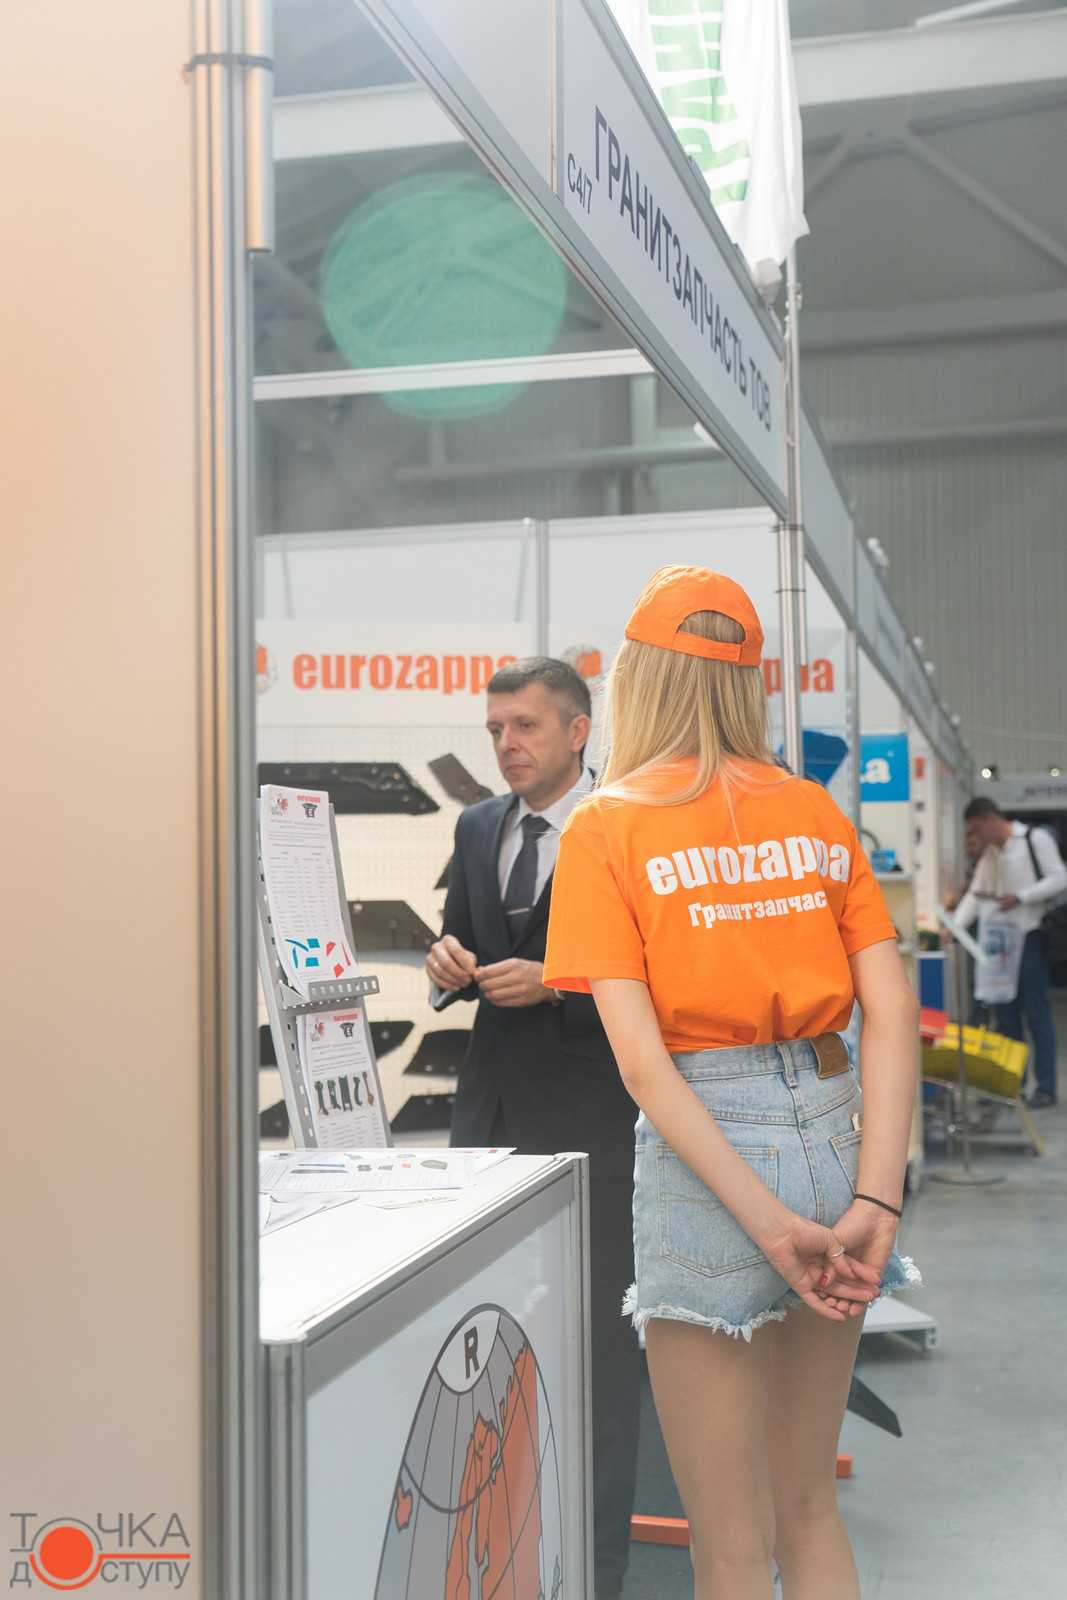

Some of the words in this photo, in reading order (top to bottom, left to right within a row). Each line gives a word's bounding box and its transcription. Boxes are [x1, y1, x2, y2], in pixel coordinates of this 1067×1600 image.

[595, 105, 747, 396] ГРАНИТЗАПЧАСТЬ
[749, 356, 771, 432] ТОВ
[645, 835, 849, 896] eurozappa
[464, 1326, 480, 1379] R
